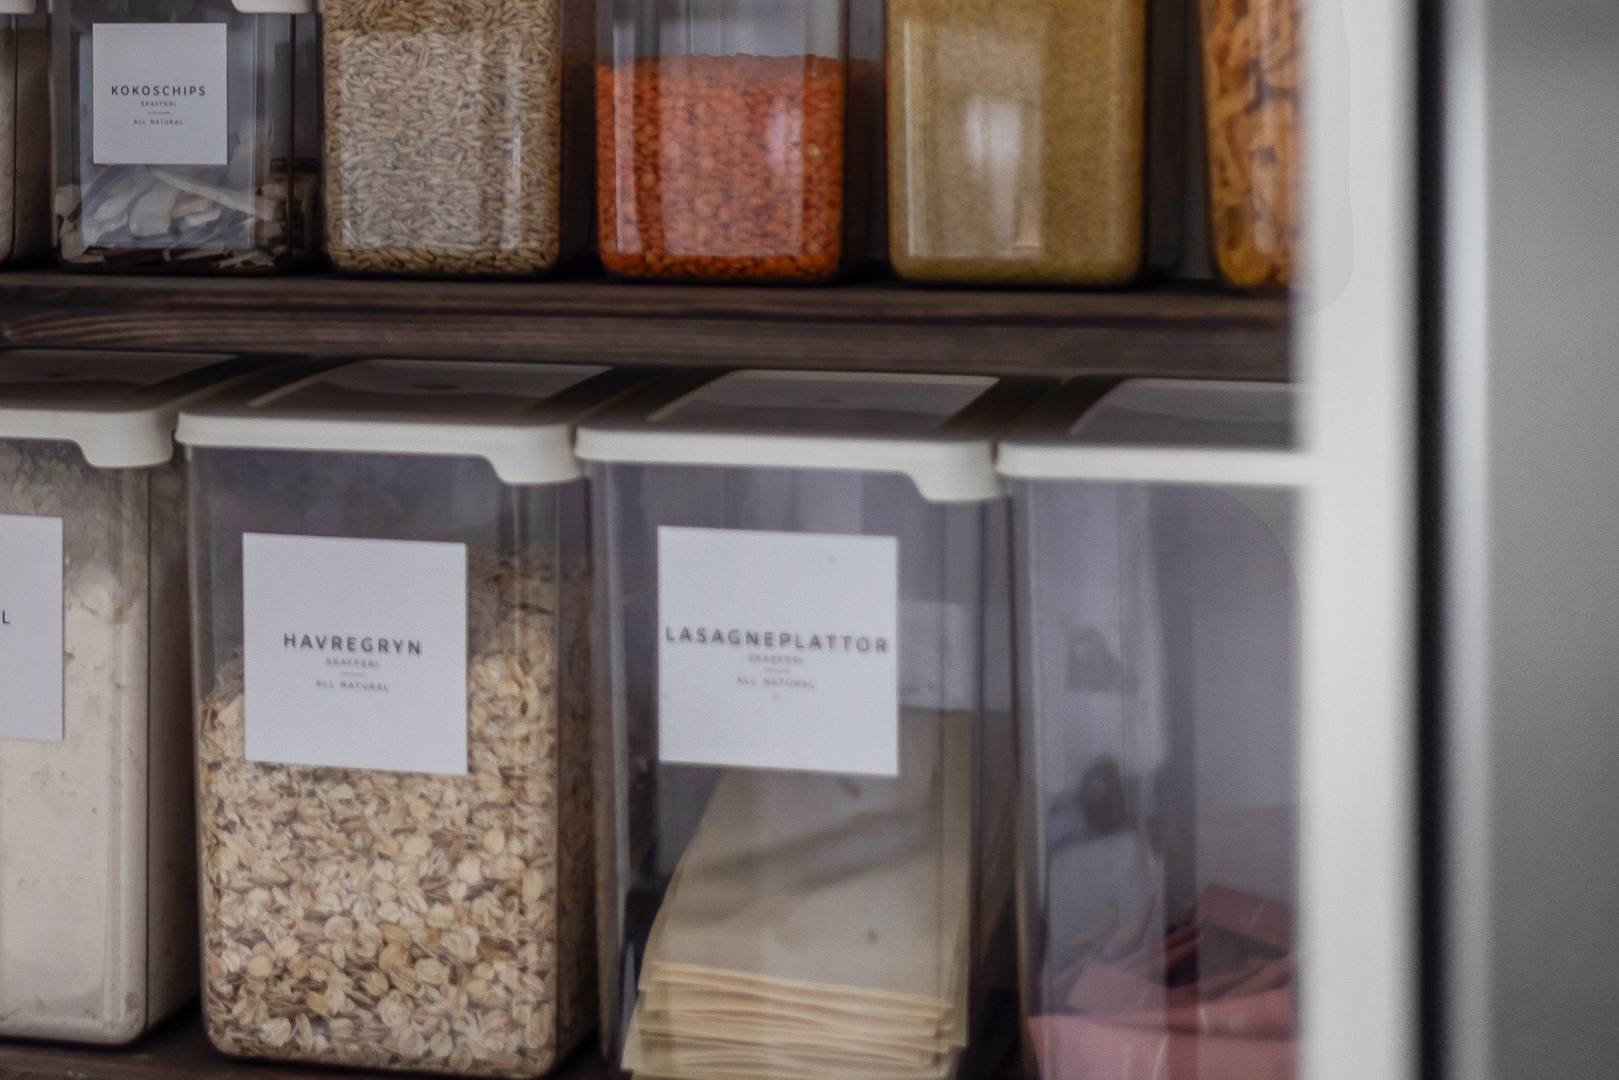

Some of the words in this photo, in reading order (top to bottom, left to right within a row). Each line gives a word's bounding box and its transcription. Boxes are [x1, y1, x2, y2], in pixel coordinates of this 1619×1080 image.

[111, 85, 206, 97] KOKOSCHIPS
[284, 633, 422, 656] HAVREGRYN
[665, 625, 889, 654] LASAGNEPLATTOR
[315, 679, 334, 688] ALL
[340, 680, 389, 692] NATURAL
